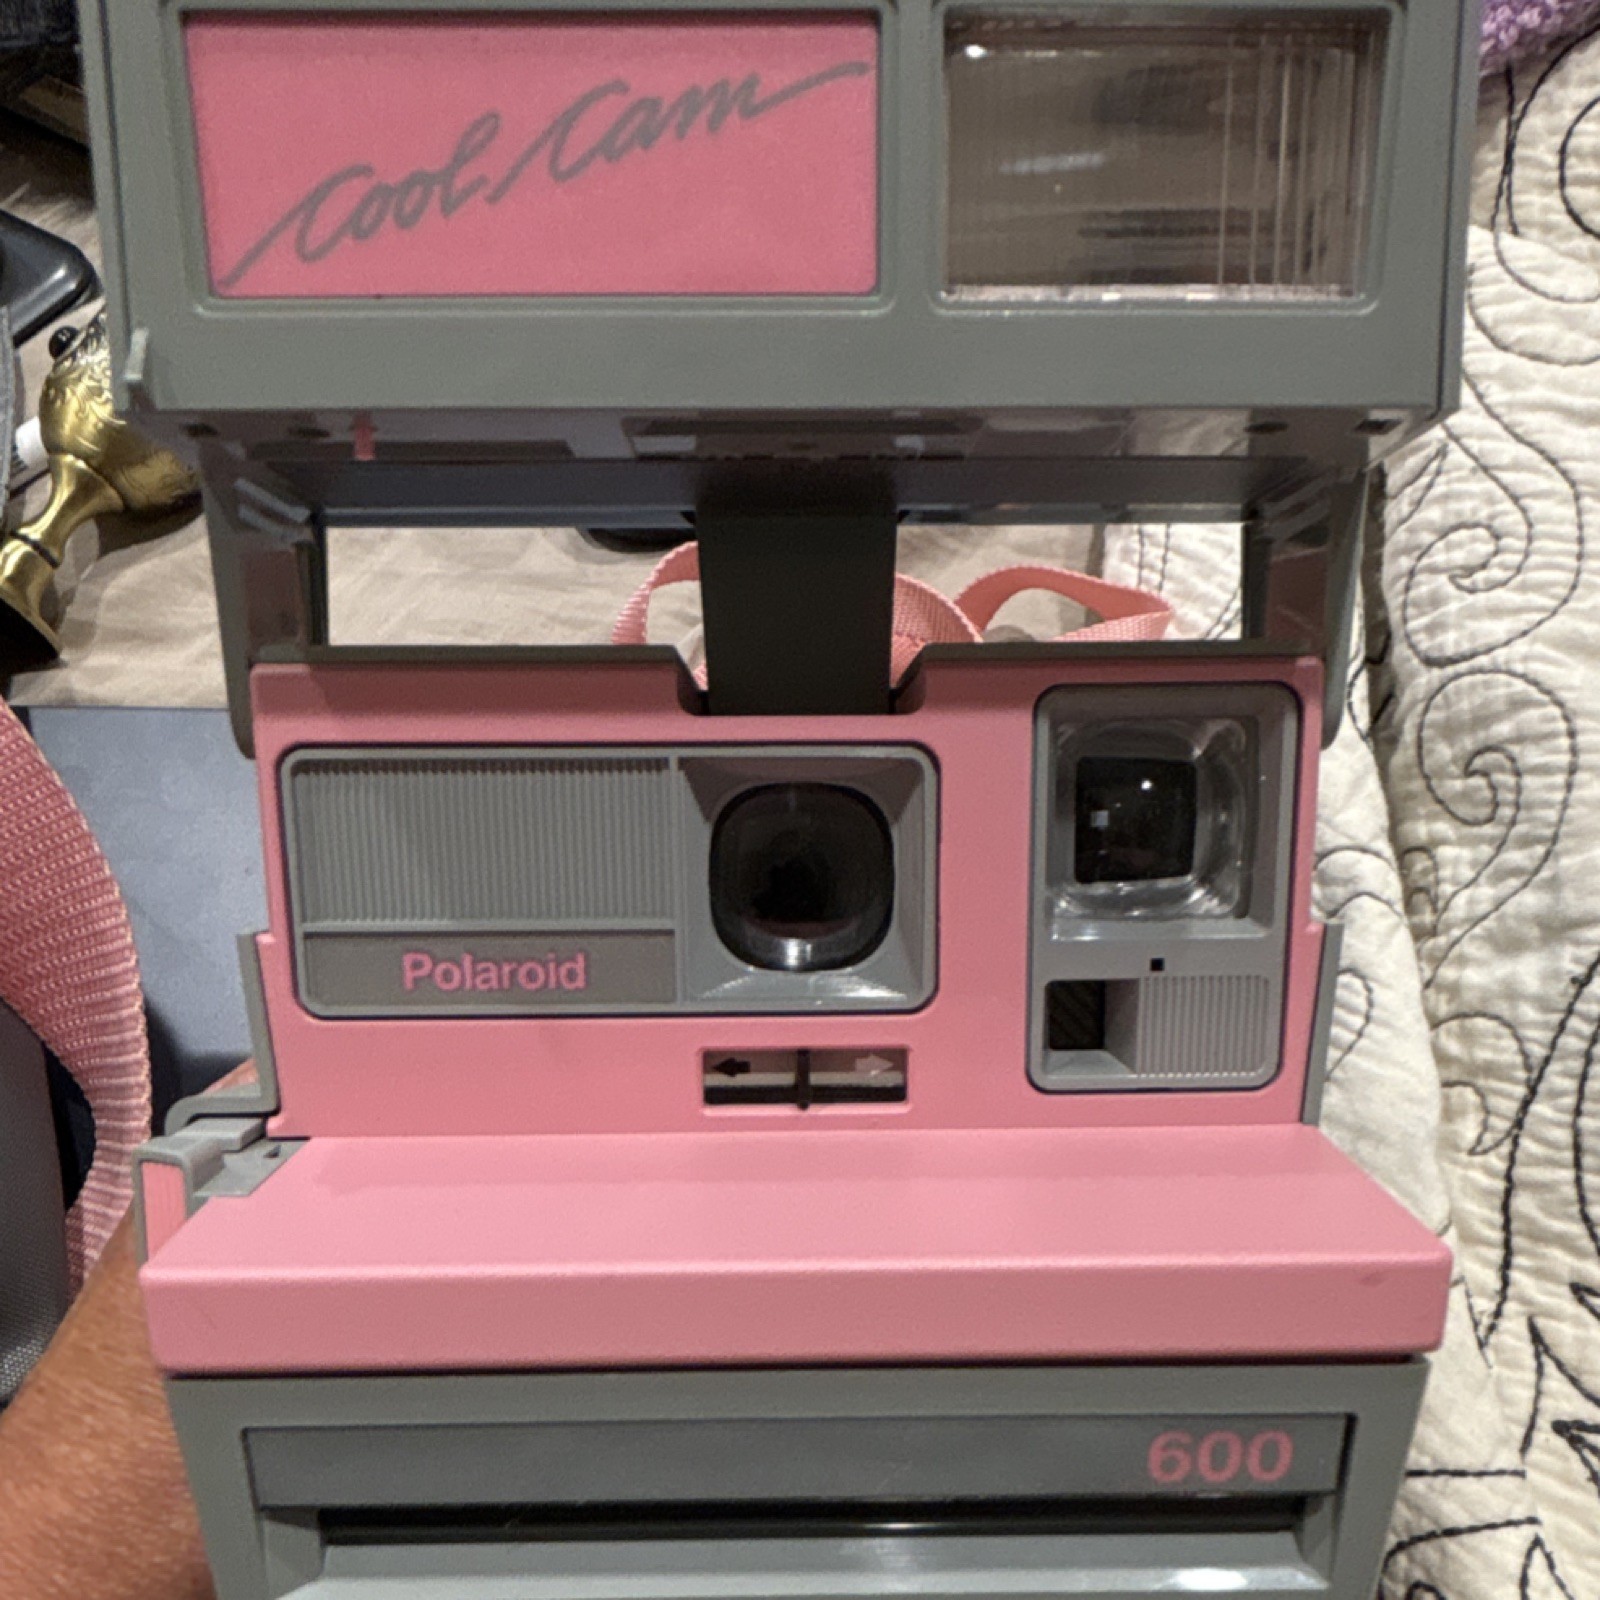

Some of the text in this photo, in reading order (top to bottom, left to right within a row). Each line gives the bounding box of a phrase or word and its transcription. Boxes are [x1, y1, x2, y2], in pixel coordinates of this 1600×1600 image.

[219, 61, 870, 287] Cool Cam
[402, 951, 586, 991] Polaroid
[1147, 1430, 1293, 1484] 600
